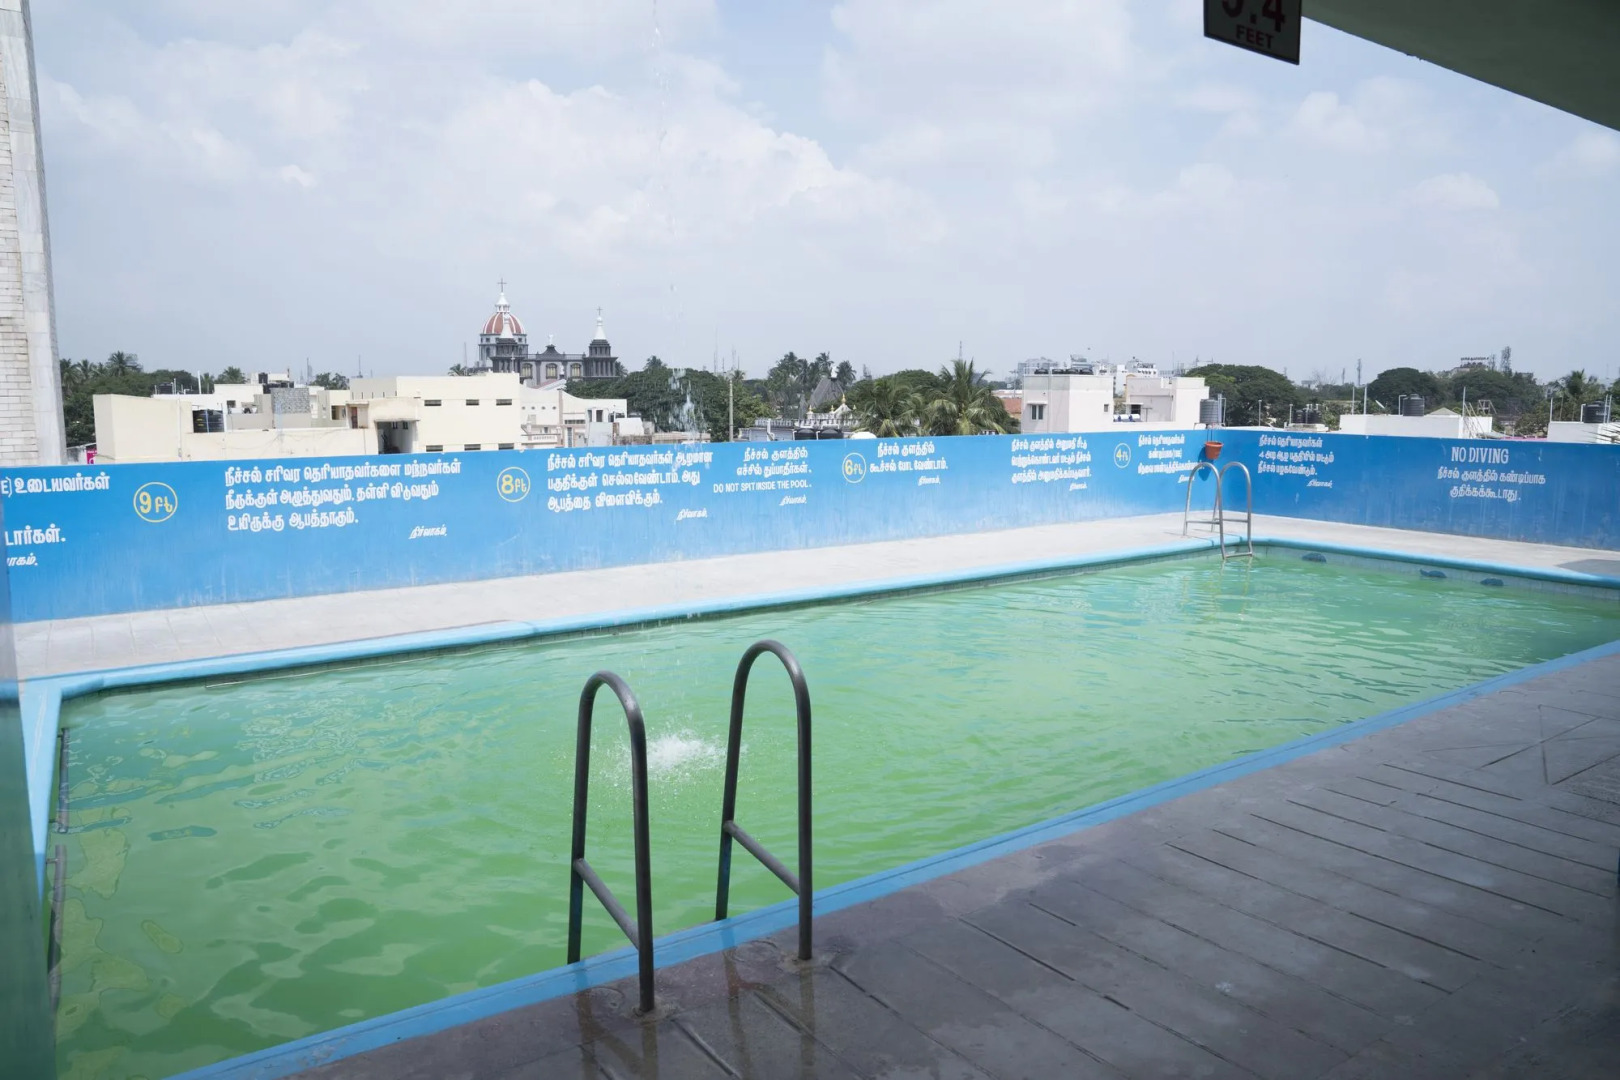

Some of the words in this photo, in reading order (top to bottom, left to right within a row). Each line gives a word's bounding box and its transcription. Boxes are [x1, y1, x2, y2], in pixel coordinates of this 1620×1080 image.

[1236, 24, 1275, 49] FEET
[743, 447, 769, 462] நீச்சல்
[771, 446, 808, 462] குளத்தில்
[877, 442, 900, 458] நீச்சல்
[901, 441, 935, 457] குளத்தில்
[1451, 446, 1467, 463] NO
[1468, 446, 1510, 464] DIVING
[547, 453, 576, 472] நீச்சல்
[578, 452, 605, 469] சரிவர
[608, 450, 673, 467] தெரியாதவர்கள்
[736, 462, 762, 476] எச்சில்
[225, 466, 262, 487] நீச்சல்
[265, 465, 301, 483] சரிவர
[304, 461, 401, 483] தெரியாதவர்களை
[404, 457, 461, 478] மற்றவர்கள்
[547, 472, 598, 492] பகுதிக்குள்
[681, 469, 700, 486] அது
[1437, 466, 1460, 480] நீச்சல்
[1461, 469, 1498, 483] குளத்தில்
[14, 472, 110, 493] உடையவர்கள்
[713, 483, 724, 494] DO
[725, 482, 740, 493] NOT
[740, 482, 755, 492] SPIT
[755, 481, 776, 491] INSIDE
[777, 480, 790, 490] THE
[790, 479, 812, 489] POOL.
[225, 488, 278, 510] நீருக்குள்
[356, 482, 389, 502] தள்ளி
[390, 480, 439, 501] விடுவதும்
[547, 493, 591, 513] ஆபத்தை
[227, 511, 285, 532] உயிருக்கு
